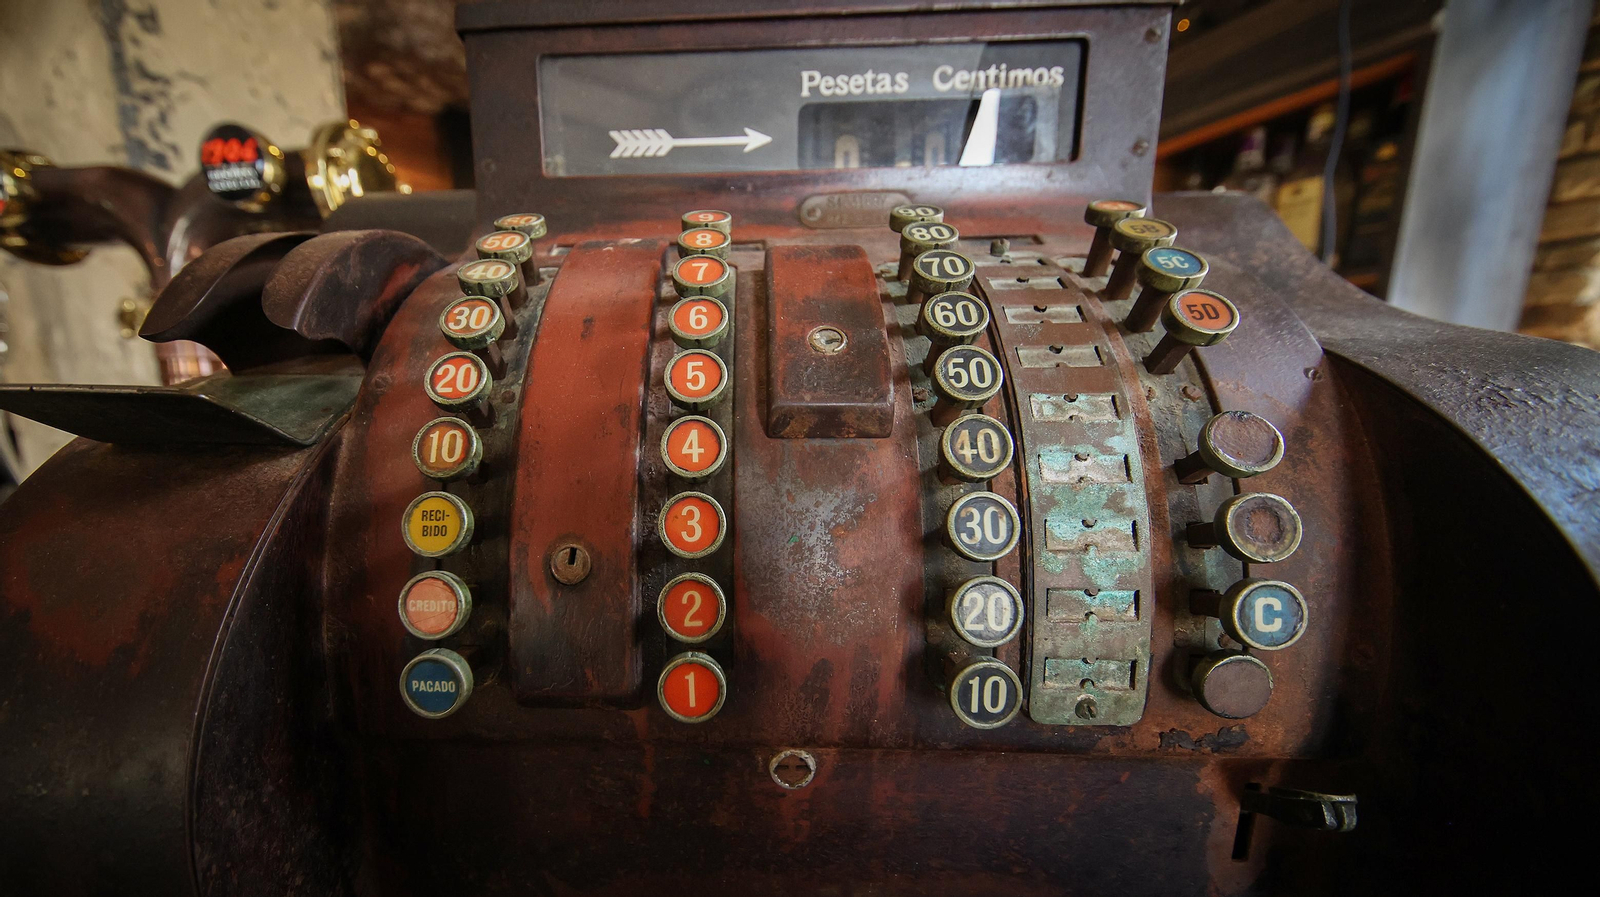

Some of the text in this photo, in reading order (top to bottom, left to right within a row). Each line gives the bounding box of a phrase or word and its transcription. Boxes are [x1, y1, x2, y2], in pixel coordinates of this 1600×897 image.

[801, 64, 1065, 97] Pesetas Centimos
[698, 213, 714, 222] 9
[899, 207, 935, 217] 90
[484, 236, 521, 249] 50
[696, 233, 712, 245] 8
[911, 226, 950, 240] 80
[467, 265, 508, 279] 40
[692, 263, 708, 281] 7
[923, 257, 965, 276] 70
[1157, 256, 1189, 269] 5C
[448, 306, 491, 330] 30
[689, 306, 708, 329] 6
[934, 301, 978, 327] 60
[1186, 303, 1219, 320] 5D
[436, 363, 478, 393] 20
[686, 361, 706, 390] 5
[948, 357, 992, 388] 50
[430, 429, 463, 463] 10
[681, 429, 704, 463] 4
[954, 428, 1000, 464] 40
[421, 510, 450, 521] RECI-
[681, 505, 701, 542] 3
[960, 506, 1007, 545] 30
[422, 525, 448, 537] BIDO
[408, 600, 456, 612] CREDITO
[681, 591, 703, 627] 2
[963, 592, 1011, 632] 20
[1254, 597, 1282, 632] C
[685, 671, 696, 708] 1
[968, 676, 1007, 714] 10
